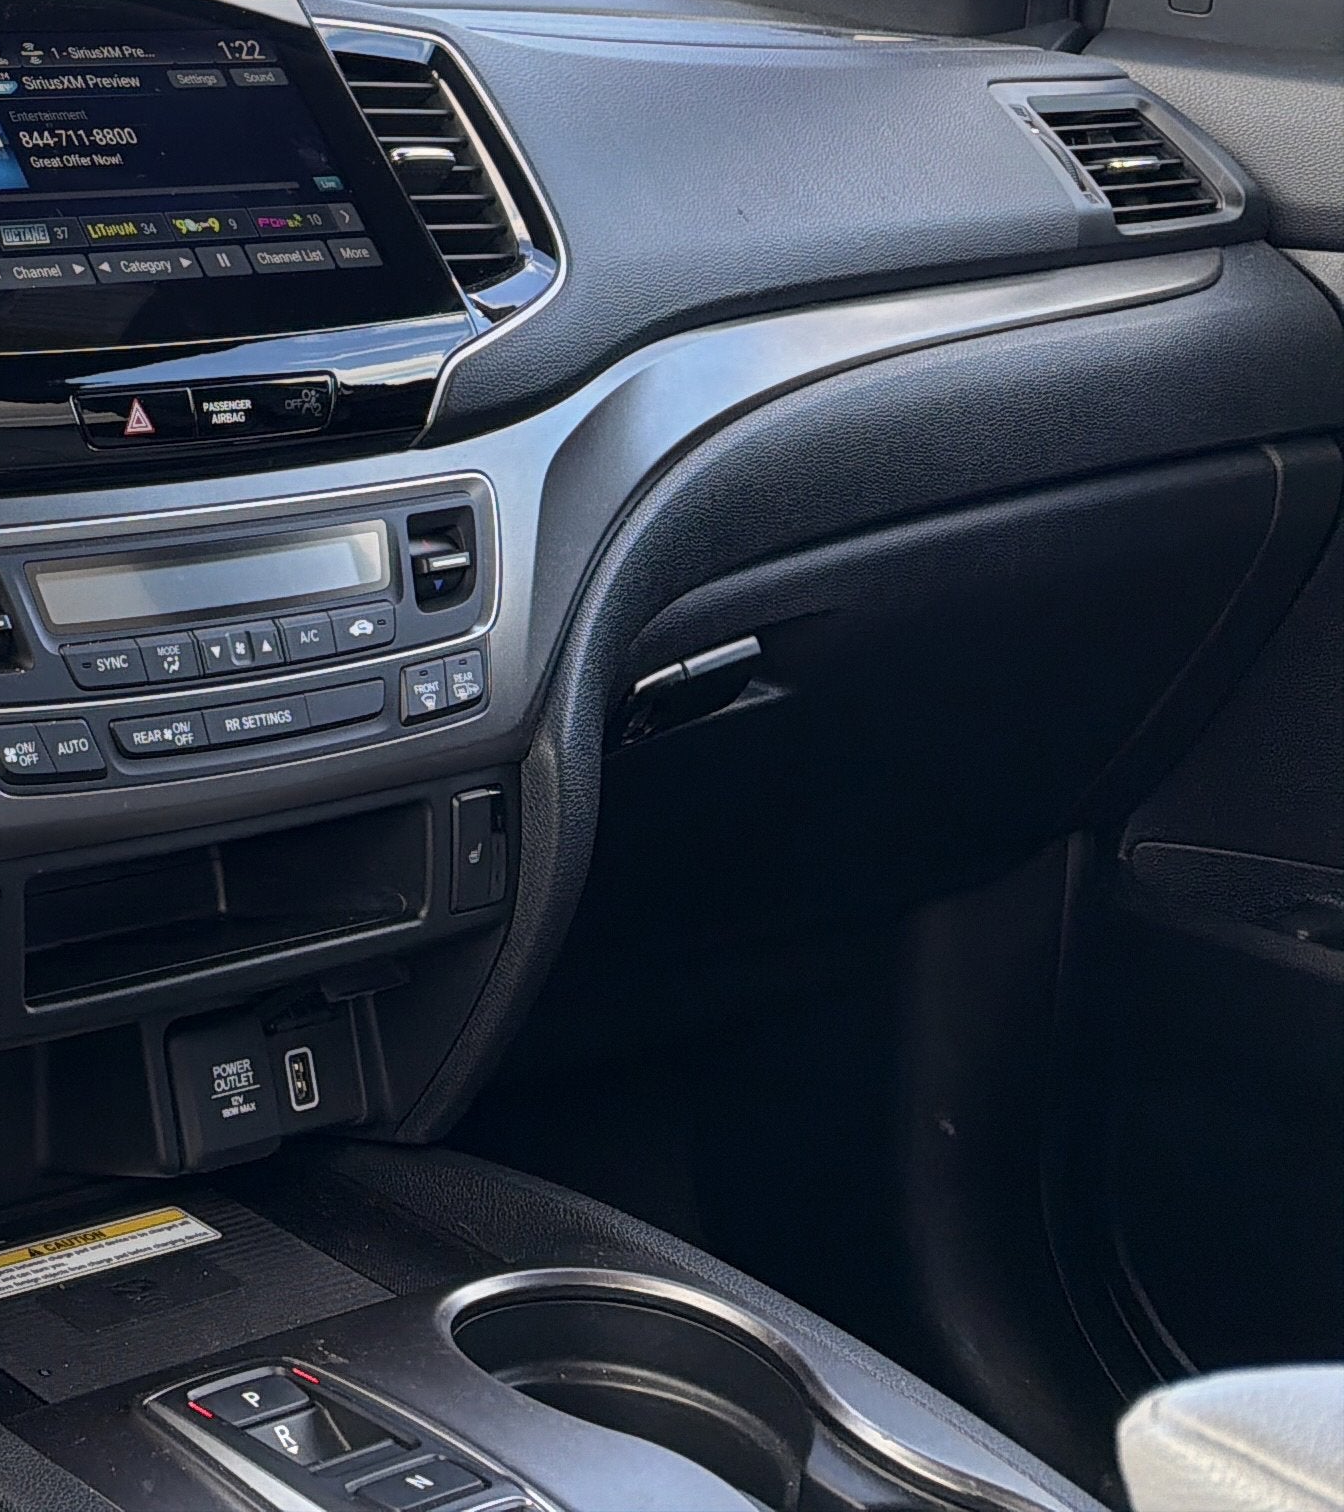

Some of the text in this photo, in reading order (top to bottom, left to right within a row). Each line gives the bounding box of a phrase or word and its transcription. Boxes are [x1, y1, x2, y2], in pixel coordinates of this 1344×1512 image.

[51, 48, 60, 59] 1
[67, 46, 123, 59] SiriusXM
[122, 45, 155, 58] Pre...
[217, 39, 266, 60] 1:22
[21, 73, 141, 90] SiriusXM Preview
[176, 73, 218, 86] Settings
[243, 71, 276, 83] Sound
[9, 109, 88, 123] Entertainment
[18, 127, 138, 148] 844-711-8800
[29, 153, 124, 168] Great Offer Now!
[227, 217, 238, 230] 9
[306, 213, 323, 226] 10
[4, 226, 69, 242] OCTANE 37
[140, 222, 158, 235] 34
[256, 249, 325, 265] Channel List
[339, 247, 370, 259] More
[12, 264, 62, 279] Channel
[120, 259, 172, 277] Category
[202, 399, 252, 413] PASSENGER
[284, 398, 303, 411] OFF
[211, 411, 246, 424] AIRBAG
[300, 629, 320, 645] A/C
[156, 644, 181, 657] MODE
[96, 655, 129, 672] SYNC
[452, 671, 474, 683] REAR
[413, 680, 440, 695] FRONT
[224, 709, 293, 732] RR SETTINGS
[132, 721, 191, 745] REAR ON/
[174, 733, 195, 747] OFF
[15, 741, 36, 754] ON/
[57, 738, 89, 756] AUTO
[18, 752, 40, 766] OFF
[212, 1058, 252, 1079] POWER
[214, 1071, 254, 1092] OUTLET
[239, 1101, 257, 1113] MAX
[42, 1230, 107, 1253] CAUTION
[241, 1391, 261, 1409] P
[273, 1424, 291, 1447] R
[404, 1474, 435, 1490] N
